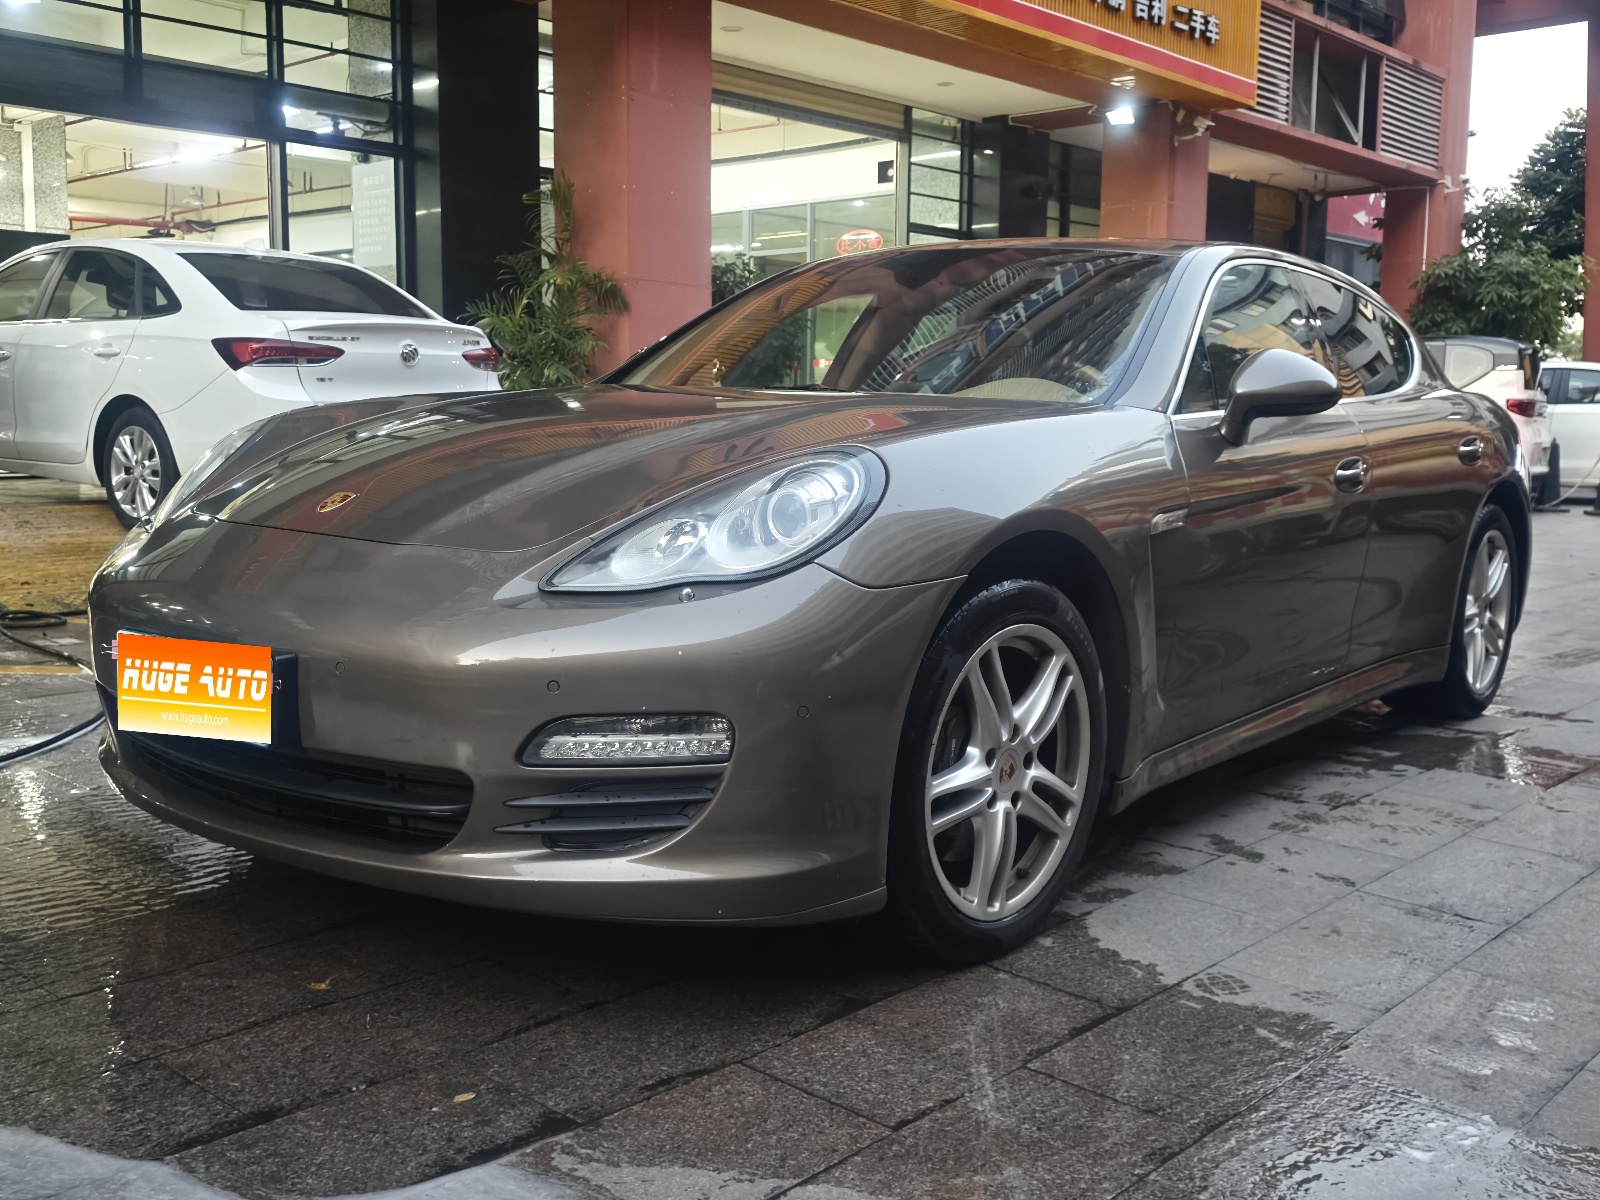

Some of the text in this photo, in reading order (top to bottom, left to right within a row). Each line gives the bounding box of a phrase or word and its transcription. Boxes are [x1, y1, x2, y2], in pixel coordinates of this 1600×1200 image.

[1136, 0, 1220, 45] 吉利 二手车
